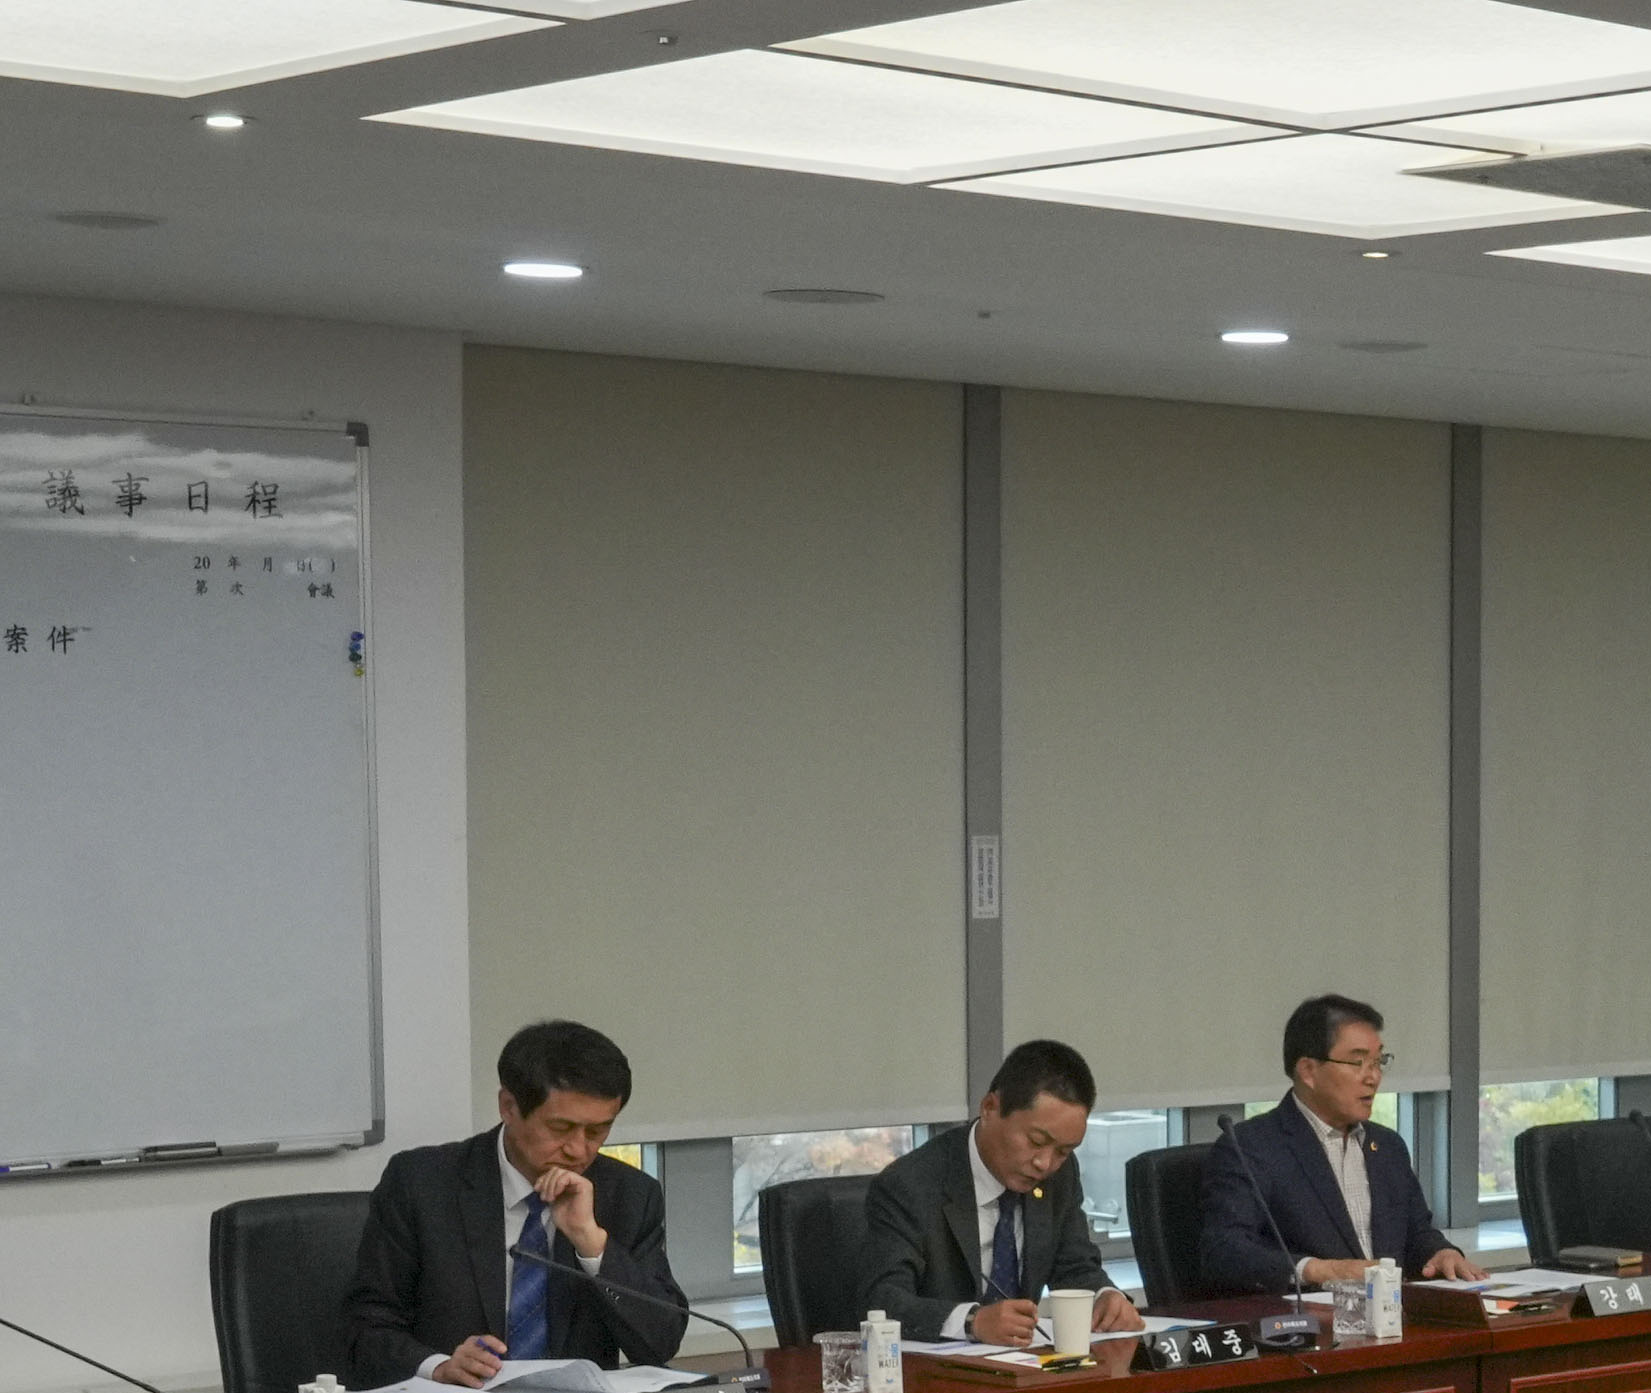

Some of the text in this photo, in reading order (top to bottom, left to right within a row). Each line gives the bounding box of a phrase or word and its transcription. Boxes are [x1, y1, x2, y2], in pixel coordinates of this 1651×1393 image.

[42, 469, 284, 518] 議事日程
[1160, 1329, 1243, 1363] 김대중
